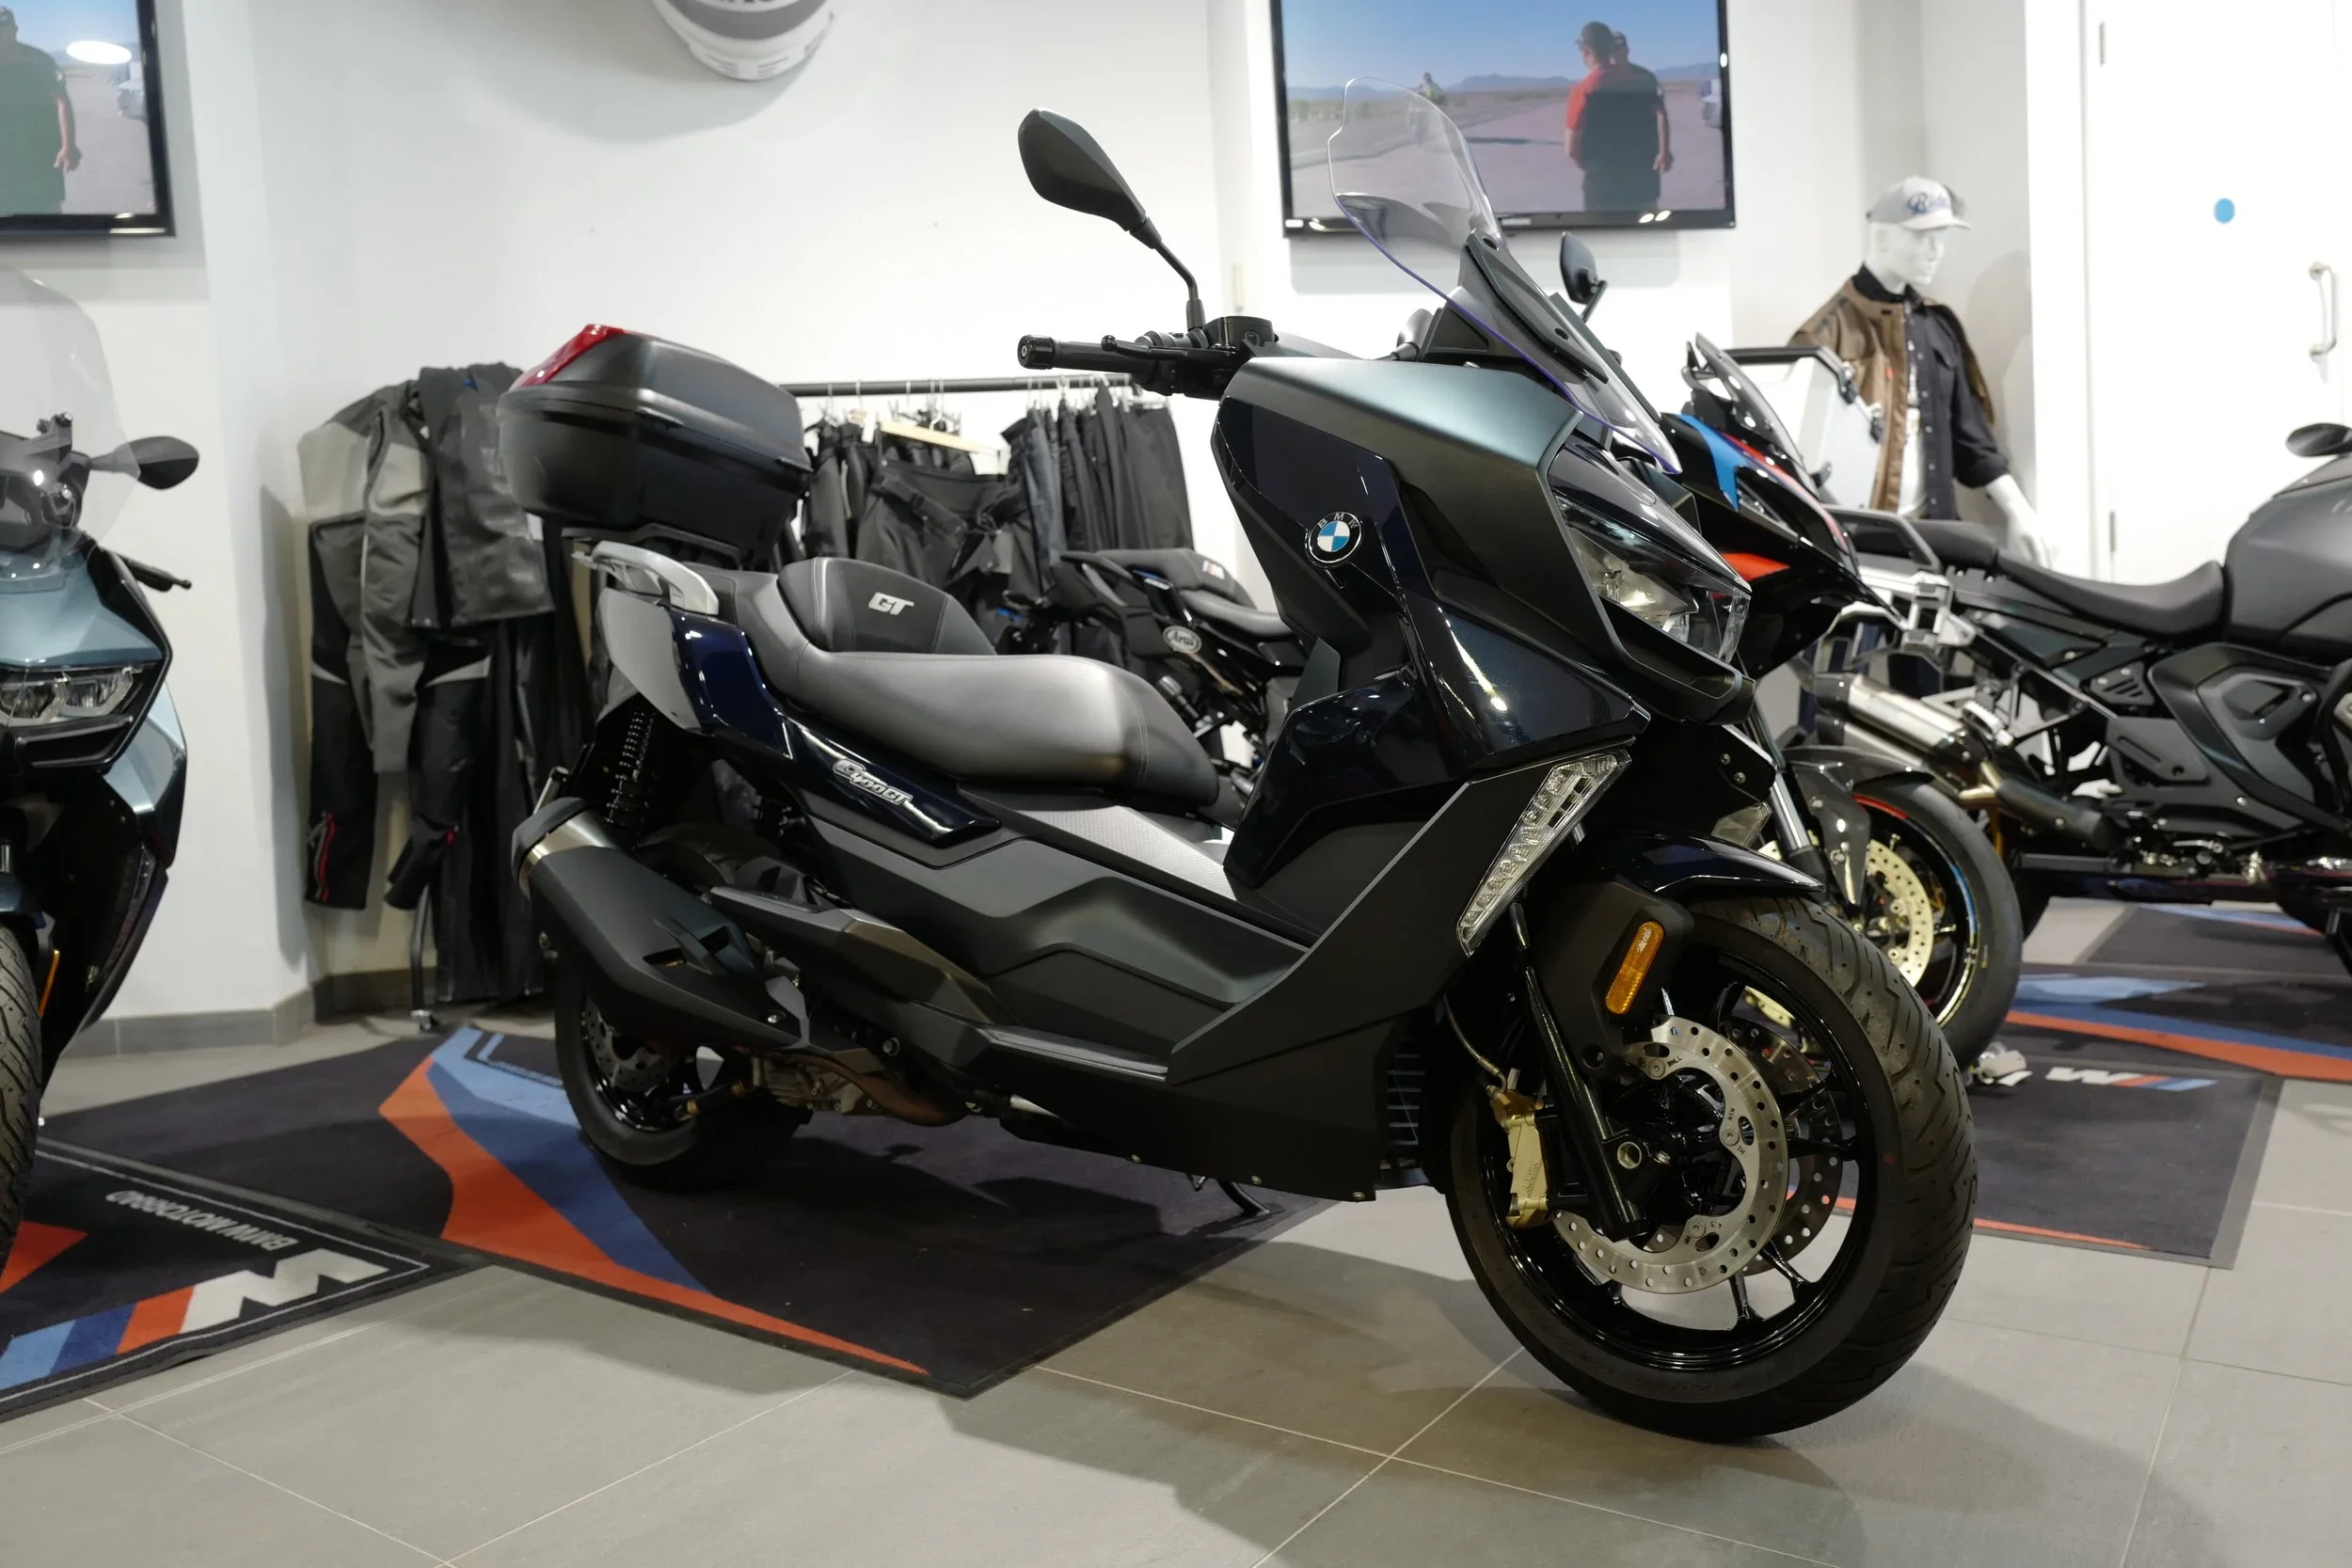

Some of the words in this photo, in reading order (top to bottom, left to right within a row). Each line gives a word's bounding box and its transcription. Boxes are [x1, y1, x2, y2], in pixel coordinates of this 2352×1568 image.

[1317, 513, 1359, 529] BMW
[868, 592, 914, 616] GT
[216, 1224, 298, 1252] BMW
